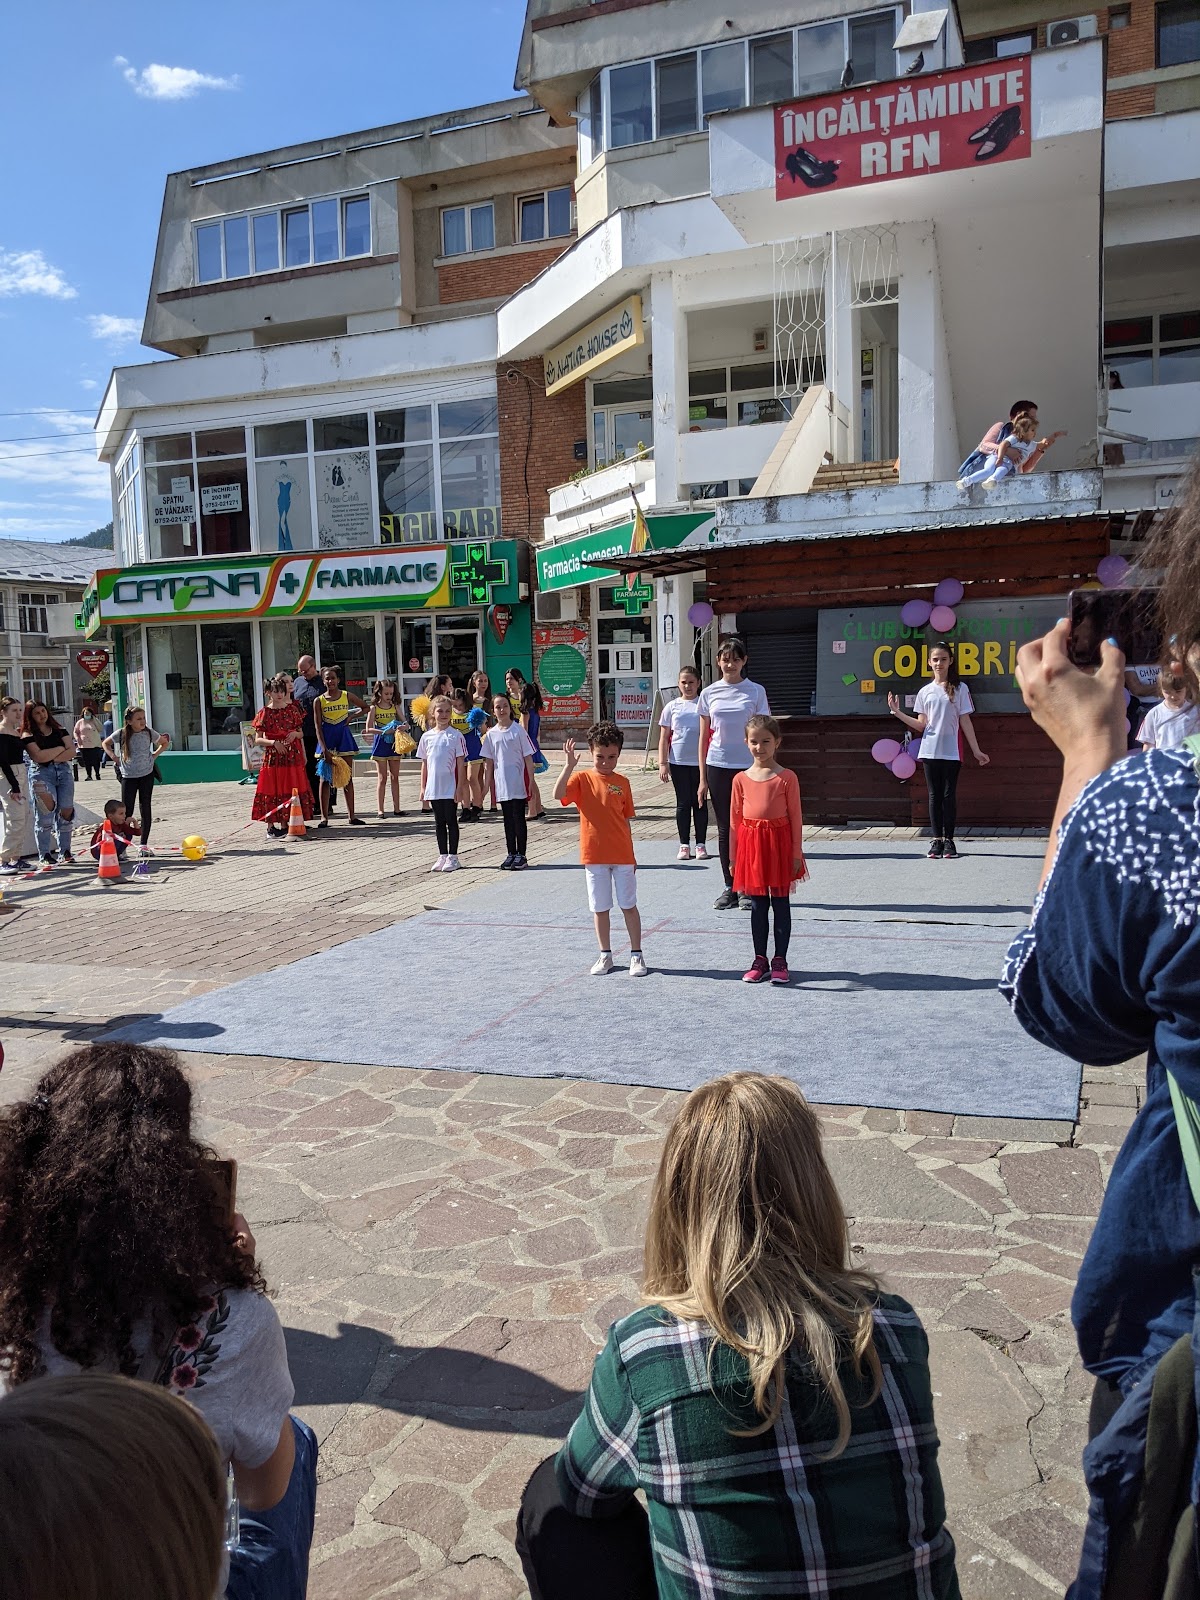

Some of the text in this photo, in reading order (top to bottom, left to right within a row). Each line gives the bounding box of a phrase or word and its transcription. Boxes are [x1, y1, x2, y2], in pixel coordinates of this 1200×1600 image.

[860, 131, 940, 178] RFN
[586, 323, 618, 360] HOUSE
[154, 508, 164, 516] DE
[316, 562, 438, 589] FARMACIE
[542, 554, 581, 580] Farmacia
[112, 572, 261, 604] CATENA
[616, 589, 649, 598] FARMACIE
[842, 619, 925, 641] CLUBUL
[616, 709, 653, 720] MEDICAMENTE
